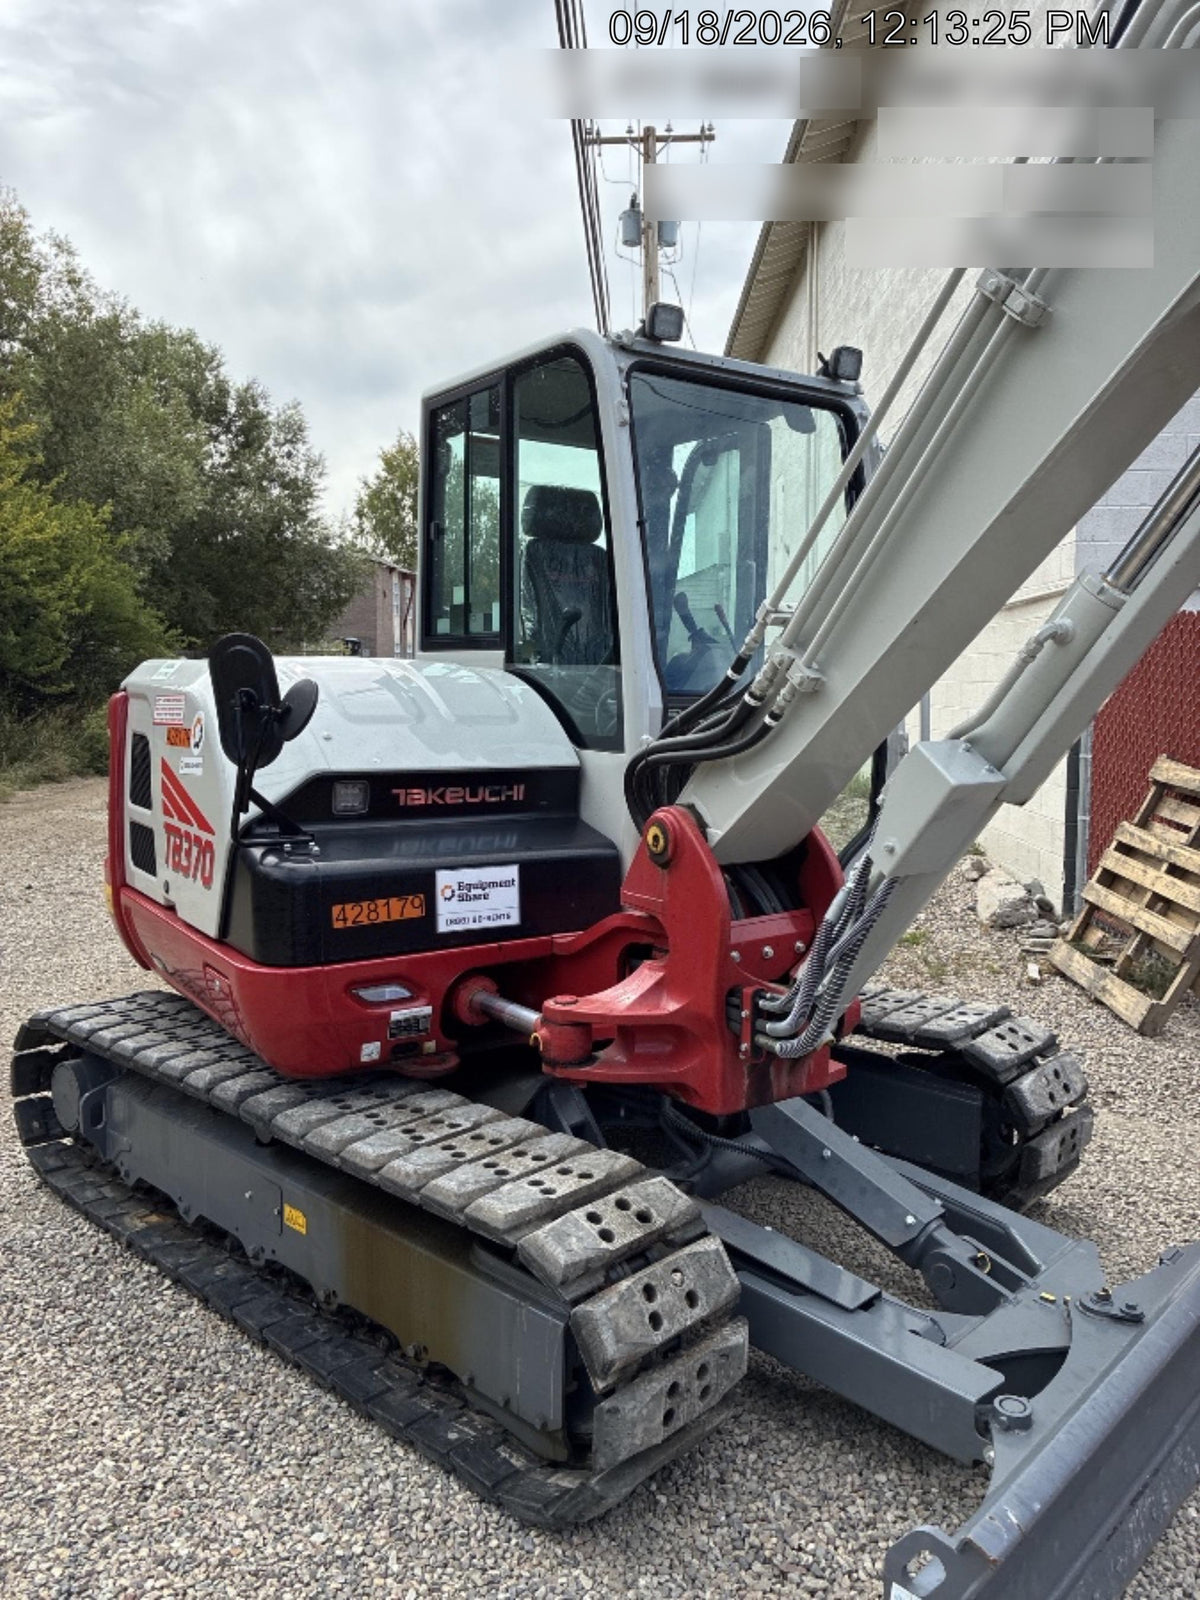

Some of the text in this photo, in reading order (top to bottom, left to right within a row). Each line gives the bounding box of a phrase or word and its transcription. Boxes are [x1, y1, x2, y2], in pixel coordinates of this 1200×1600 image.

[163, 822, 216, 890] TB370
[457, 878, 516, 893] Equipment
[457, 892, 490, 903] Share
[335, 895, 424, 925] 428179
